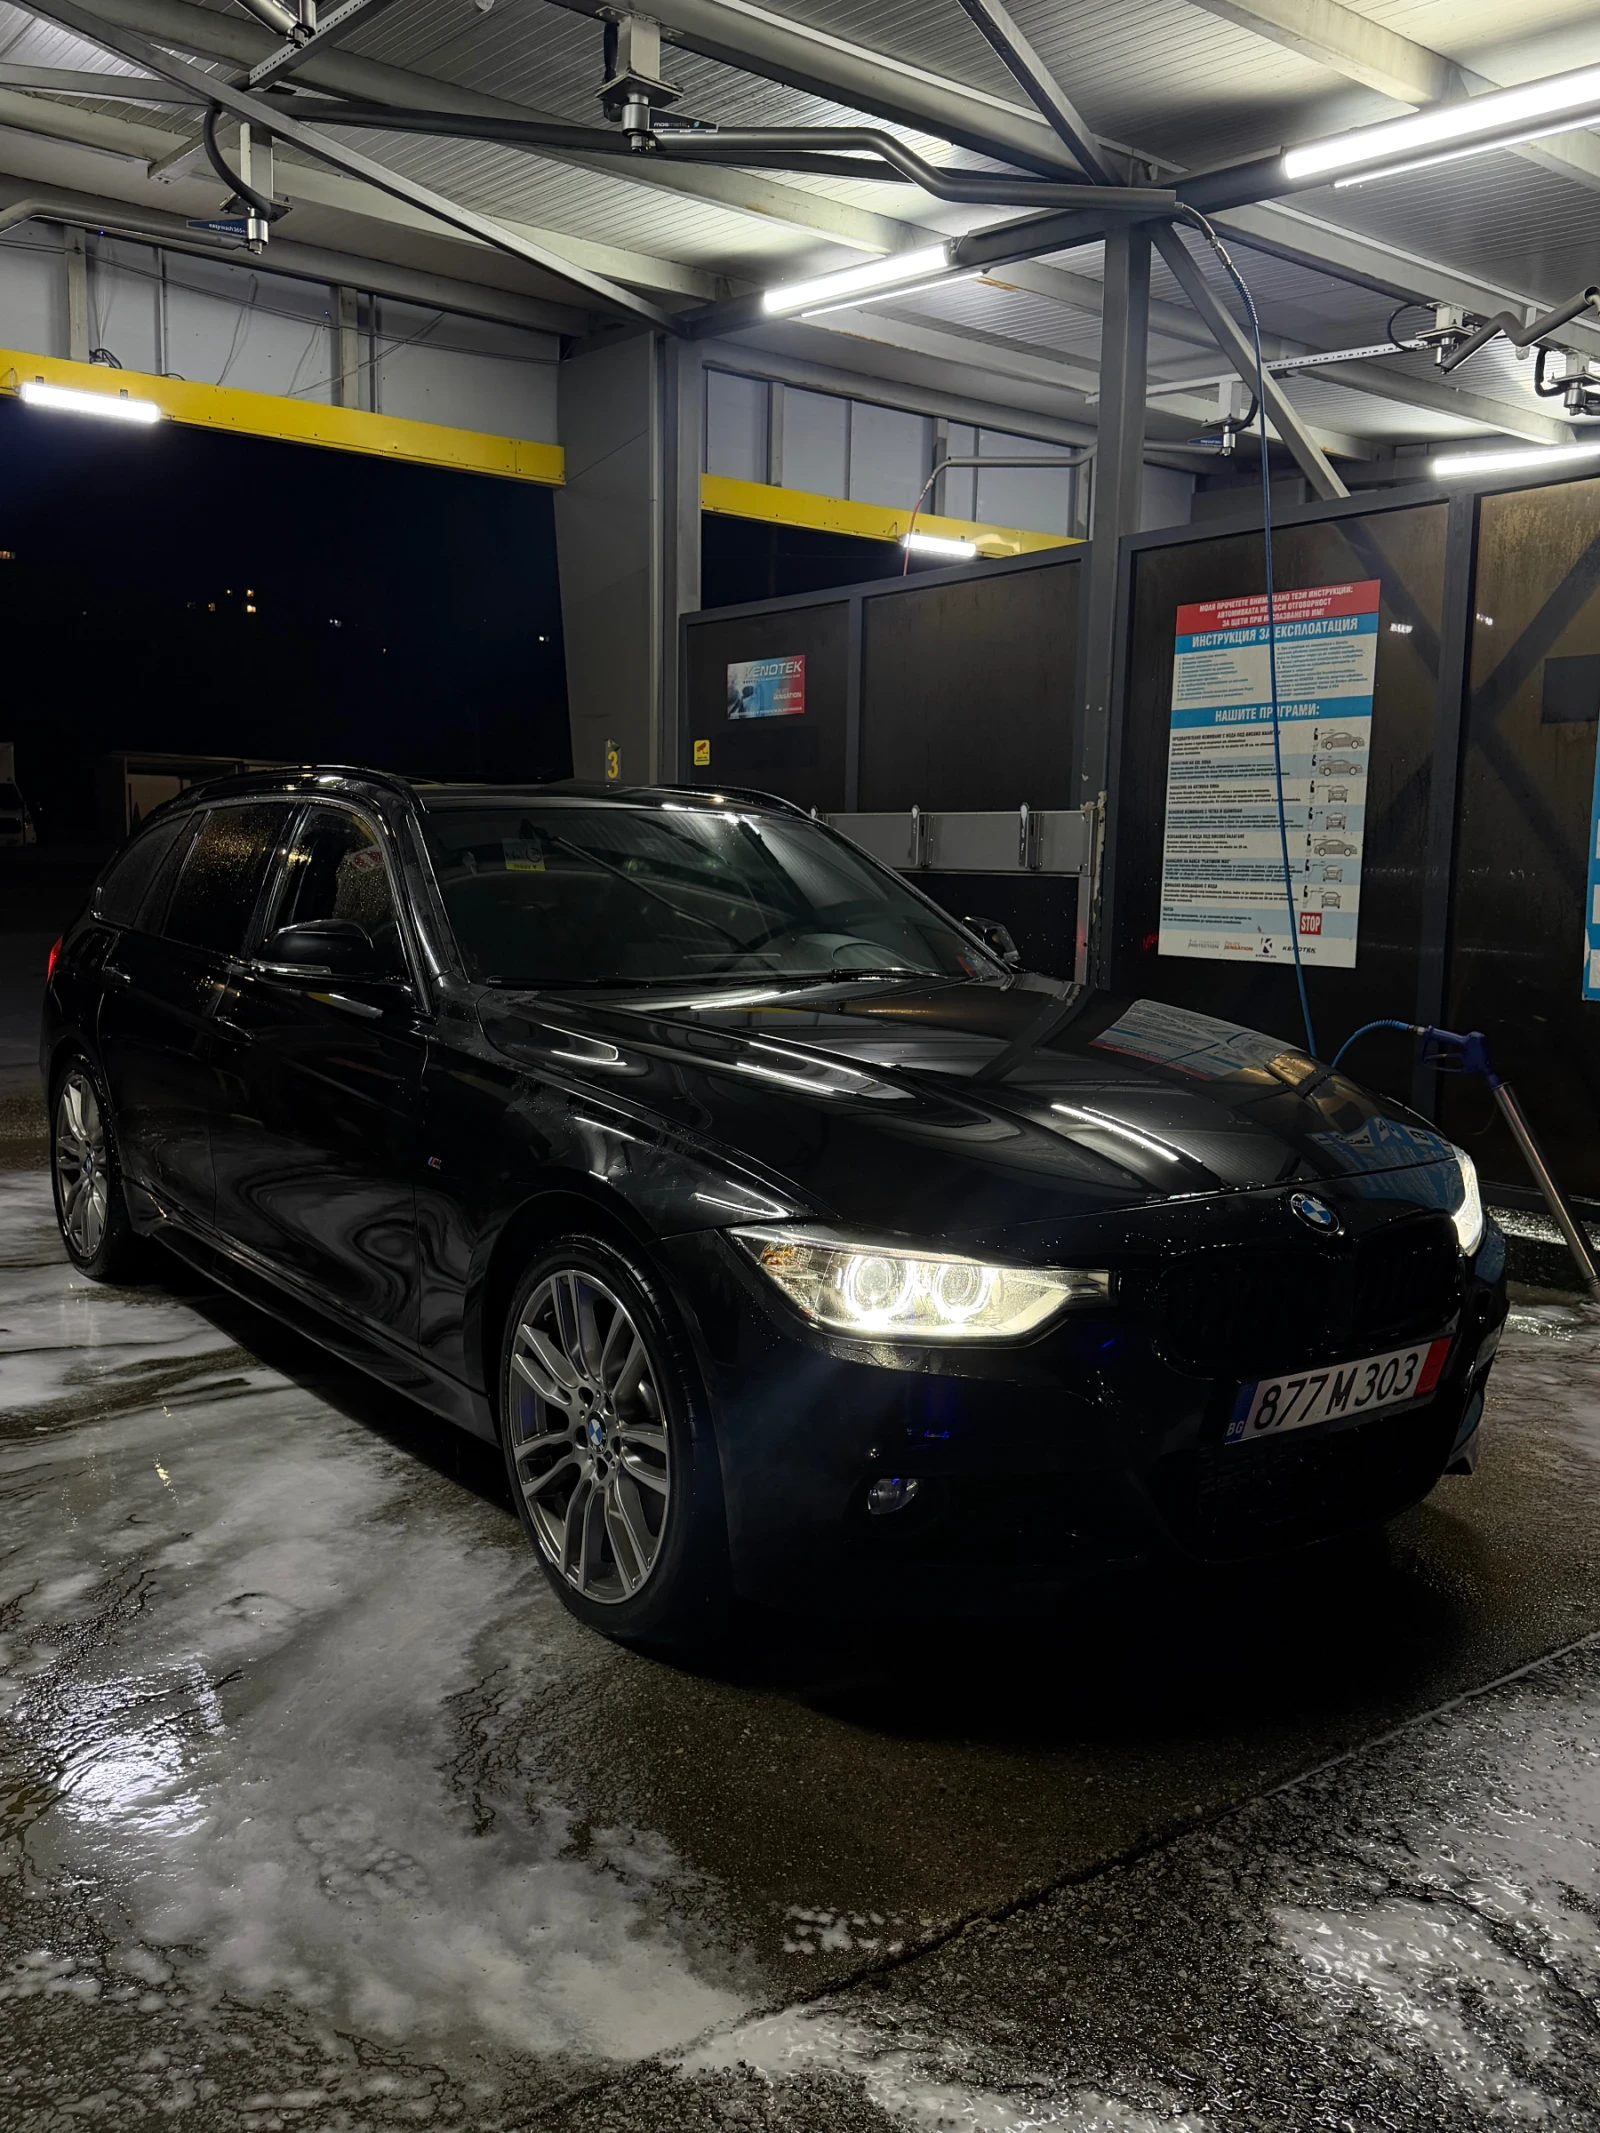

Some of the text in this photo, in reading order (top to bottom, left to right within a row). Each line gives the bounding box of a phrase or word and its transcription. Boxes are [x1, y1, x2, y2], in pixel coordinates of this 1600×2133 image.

[1199, 585, 1354, 613] МОЛЯ ПРОЧЕТЕТЕ ВНИМТЕЛНО ТЕЗИ ИНСТРУКЦИИ:
[1216, 607, 1259, 619] АВТОМИВКАТА
[1271, 603, 1287, 612] ОСИ
[1287, 597, 1332, 609] ОТГОВОРНОСТ
[1222, 619, 1230, 627] ЗА
[1230, 617, 1248, 627] ЩЕТИ
[1249, 615, 1263, 624] ПРИ
[1263, 610, 1310, 622] НСПАЗВАНЕТО
[1191, 629, 1257, 648] ИНСТРУКЦИЯ
[1274, 617, 1358, 639] ЕКСПЛОАТАЦИЯ
[1215, 708, 1256, 722] НАШИТЕ
[607, 750, 619, 779] 3
[1300, 915, 1321, 932] STOP
[1282, 945, 1317, 954] KEOTEK
[1225, 1420, 1246, 1437] BG
